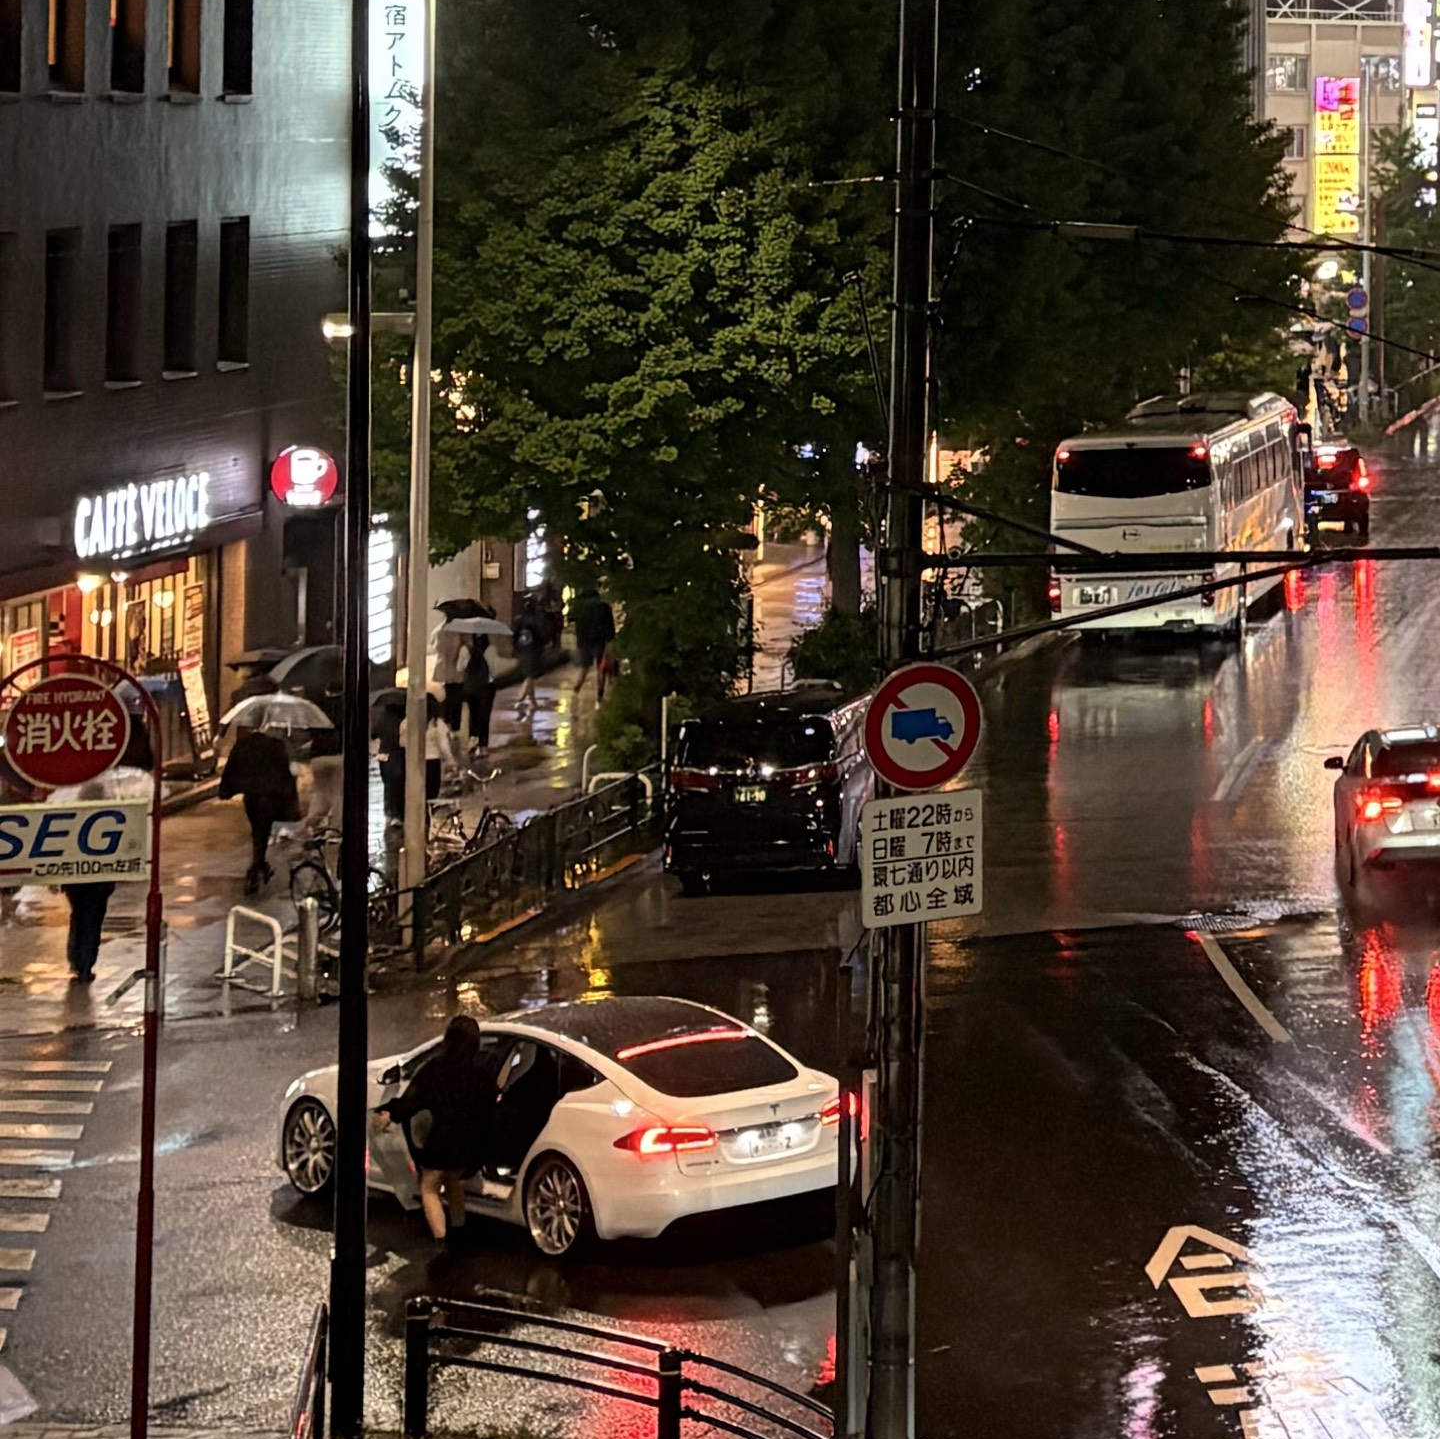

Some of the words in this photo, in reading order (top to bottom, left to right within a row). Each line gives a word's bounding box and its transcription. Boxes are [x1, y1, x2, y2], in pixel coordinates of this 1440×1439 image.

[139, 471, 210, 541] VELOCE
[26, 694, 51, 706] FIRE
[16, 708, 118, 755] 消火栓
[872, 804, 974, 832] 土曜22時から
[0, 810, 126, 861] SEG
[873, 836, 906, 861] 日曜
[921, 831, 975, 855] 7時まで
[873, 856, 974, 888] 環七通り以内
[873, 883, 974, 917] 都心全域
